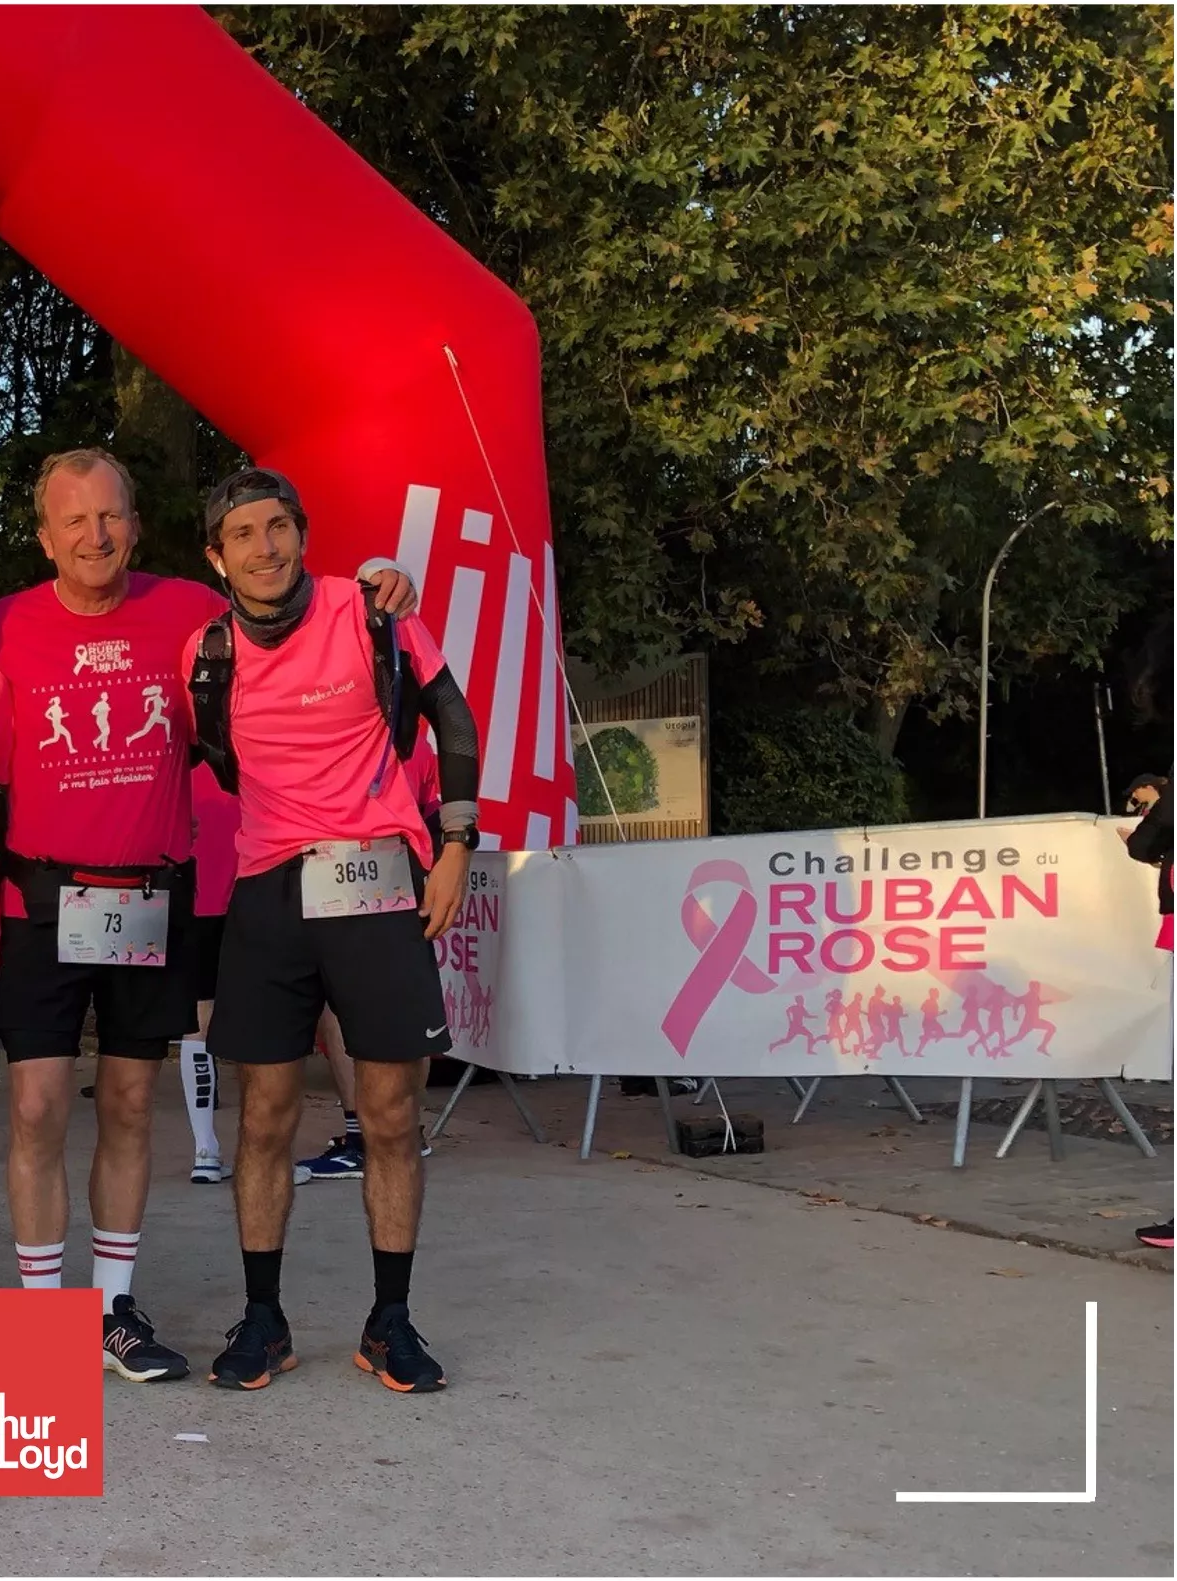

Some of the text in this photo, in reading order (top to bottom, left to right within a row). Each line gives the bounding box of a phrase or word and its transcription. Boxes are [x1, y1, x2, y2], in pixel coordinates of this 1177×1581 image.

[334, 860, 378, 884] 3649
[768, 846, 1059, 876] Challenge du
[769, 872, 1059, 926] RUBAN
[103, 913, 123, 933] 73
[768, 926, 987, 974] ROSE
